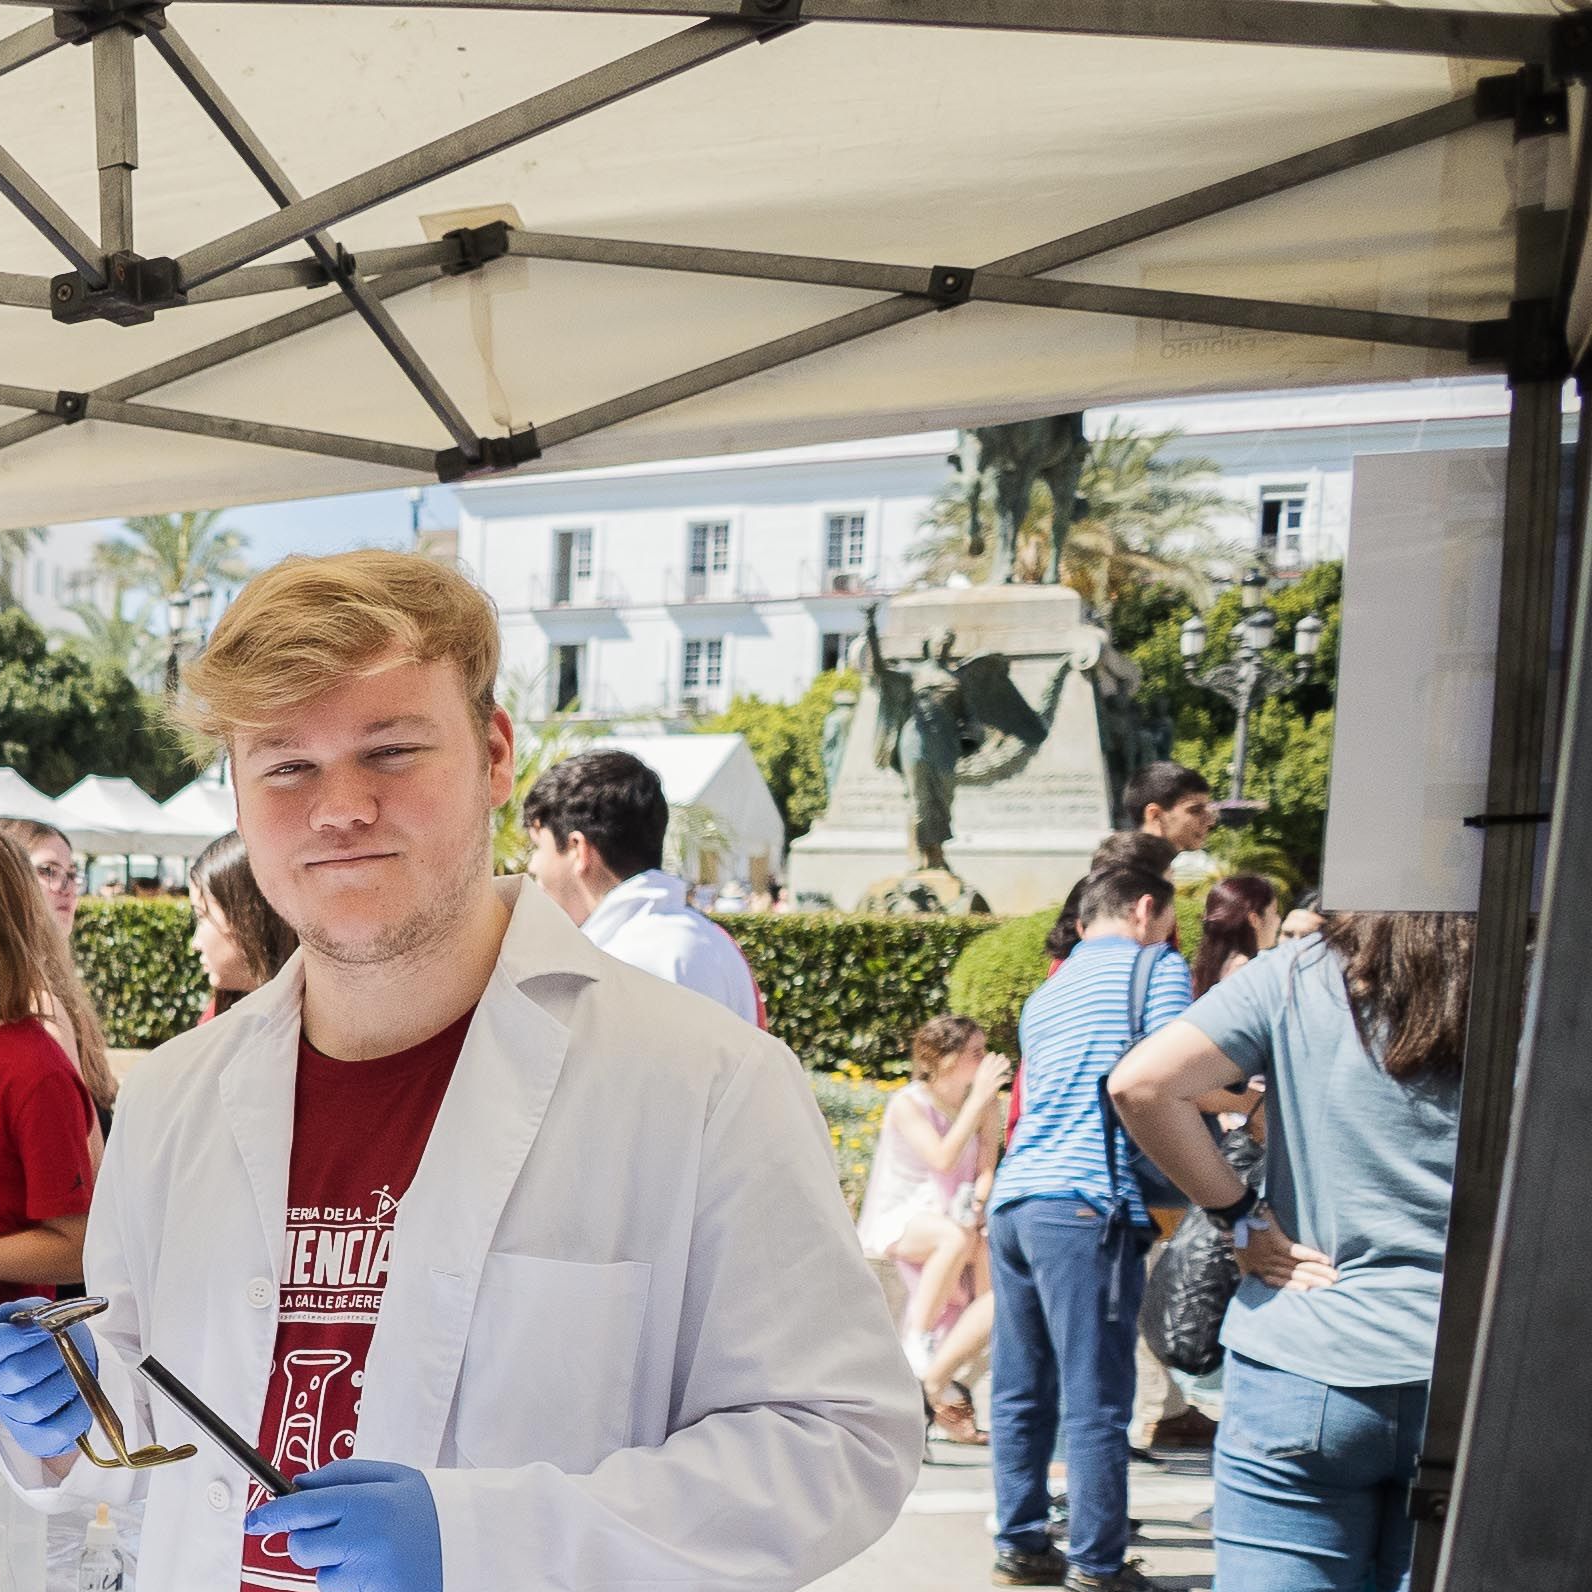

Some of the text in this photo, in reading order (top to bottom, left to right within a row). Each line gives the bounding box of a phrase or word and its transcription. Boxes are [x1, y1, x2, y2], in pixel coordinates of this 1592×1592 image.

[323, 1207, 345, 1221] DE
[346, 1206, 362, 1220] LA
[280, 1229, 394, 1285] IENCIA
[295, 1294, 334, 1309] CALLE
[335, 1295, 349, 1309] DE
[349, 1294, 382, 1309] JERE
